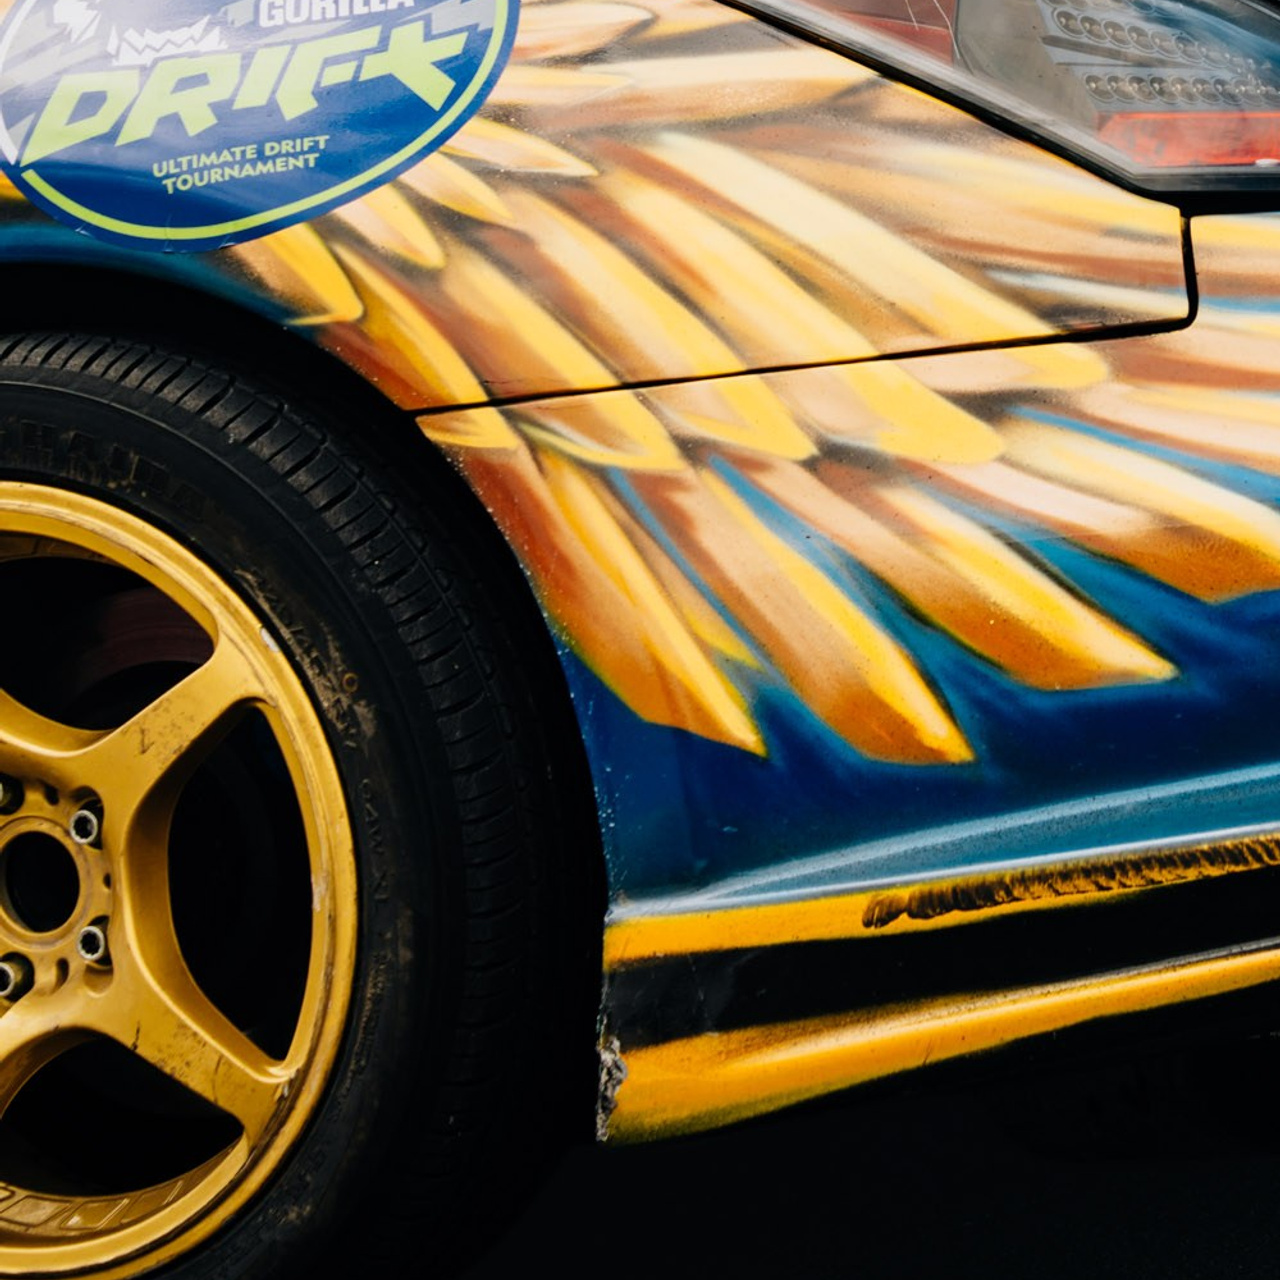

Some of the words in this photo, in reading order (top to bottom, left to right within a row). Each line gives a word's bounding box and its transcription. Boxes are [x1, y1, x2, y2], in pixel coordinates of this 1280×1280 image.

[20, 21, 468, 167] DRIFT
[153, 145, 257, 177] ULTIMATE
[265, 136, 328, 155] DRIFT
[162, 154, 319, 194] TOURNAMENT
